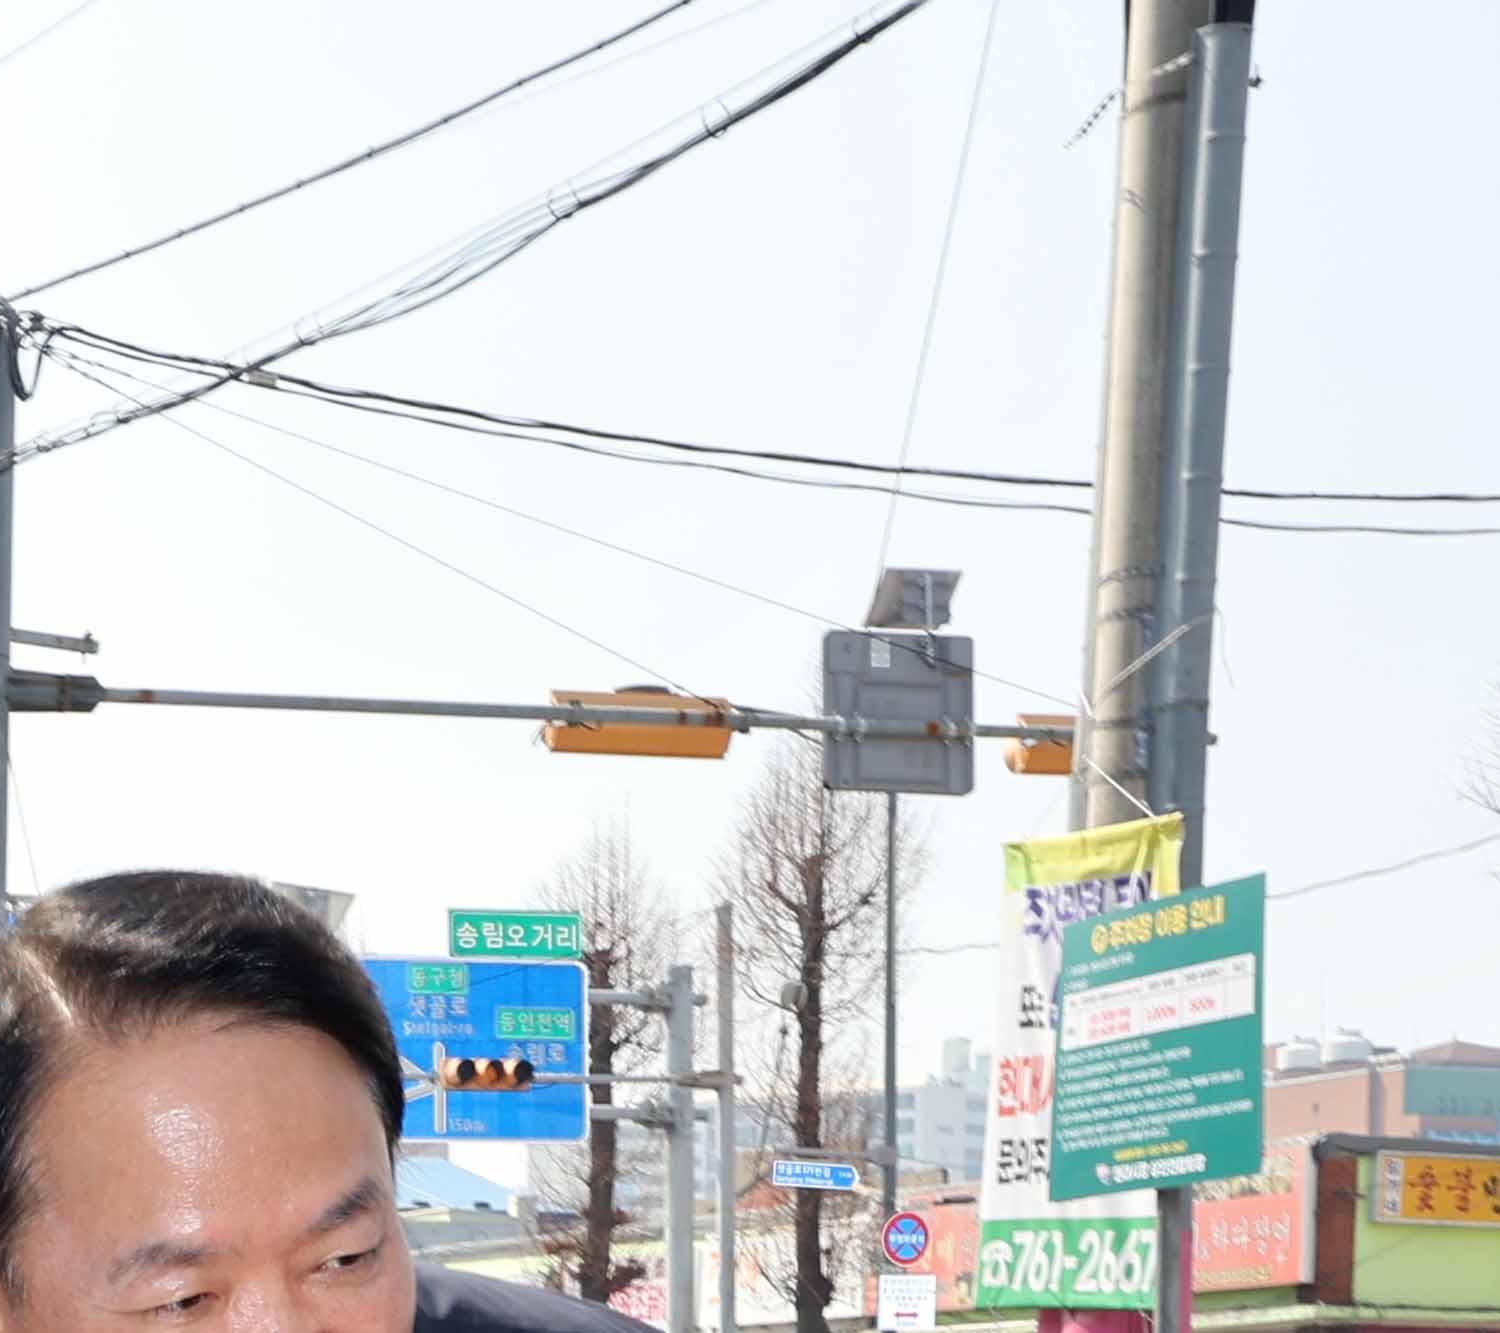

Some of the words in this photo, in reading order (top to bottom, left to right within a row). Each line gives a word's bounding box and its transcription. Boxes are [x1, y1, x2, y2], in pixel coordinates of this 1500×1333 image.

[456, 921, 577, 950] 송림오거리
[501, 1010, 570, 1034] 동인천역
[1012, 1229, 1157, 1294] 761-2667
